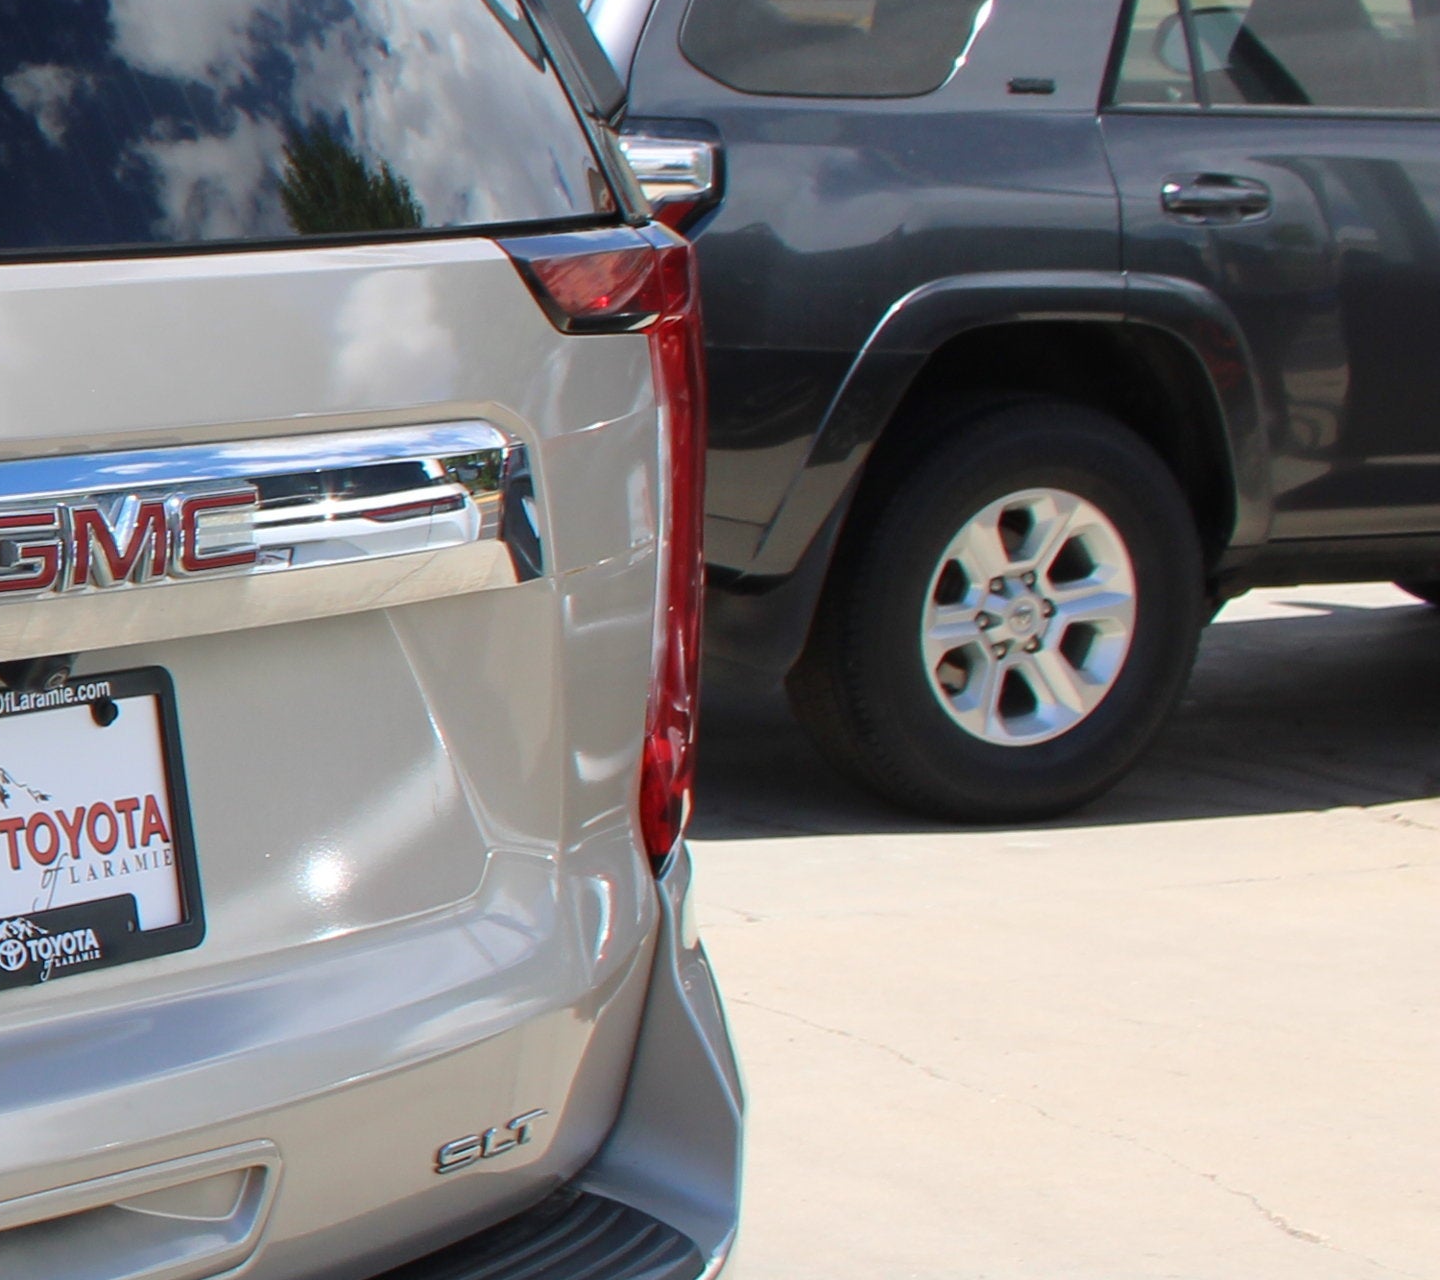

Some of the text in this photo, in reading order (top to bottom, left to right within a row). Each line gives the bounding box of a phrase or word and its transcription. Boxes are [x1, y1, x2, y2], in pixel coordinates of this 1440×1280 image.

[70, 848, 173, 884] LARAMIE
[26, 928, 99, 961] TOYOTA
[436, 1109, 548, 1174] SLT
